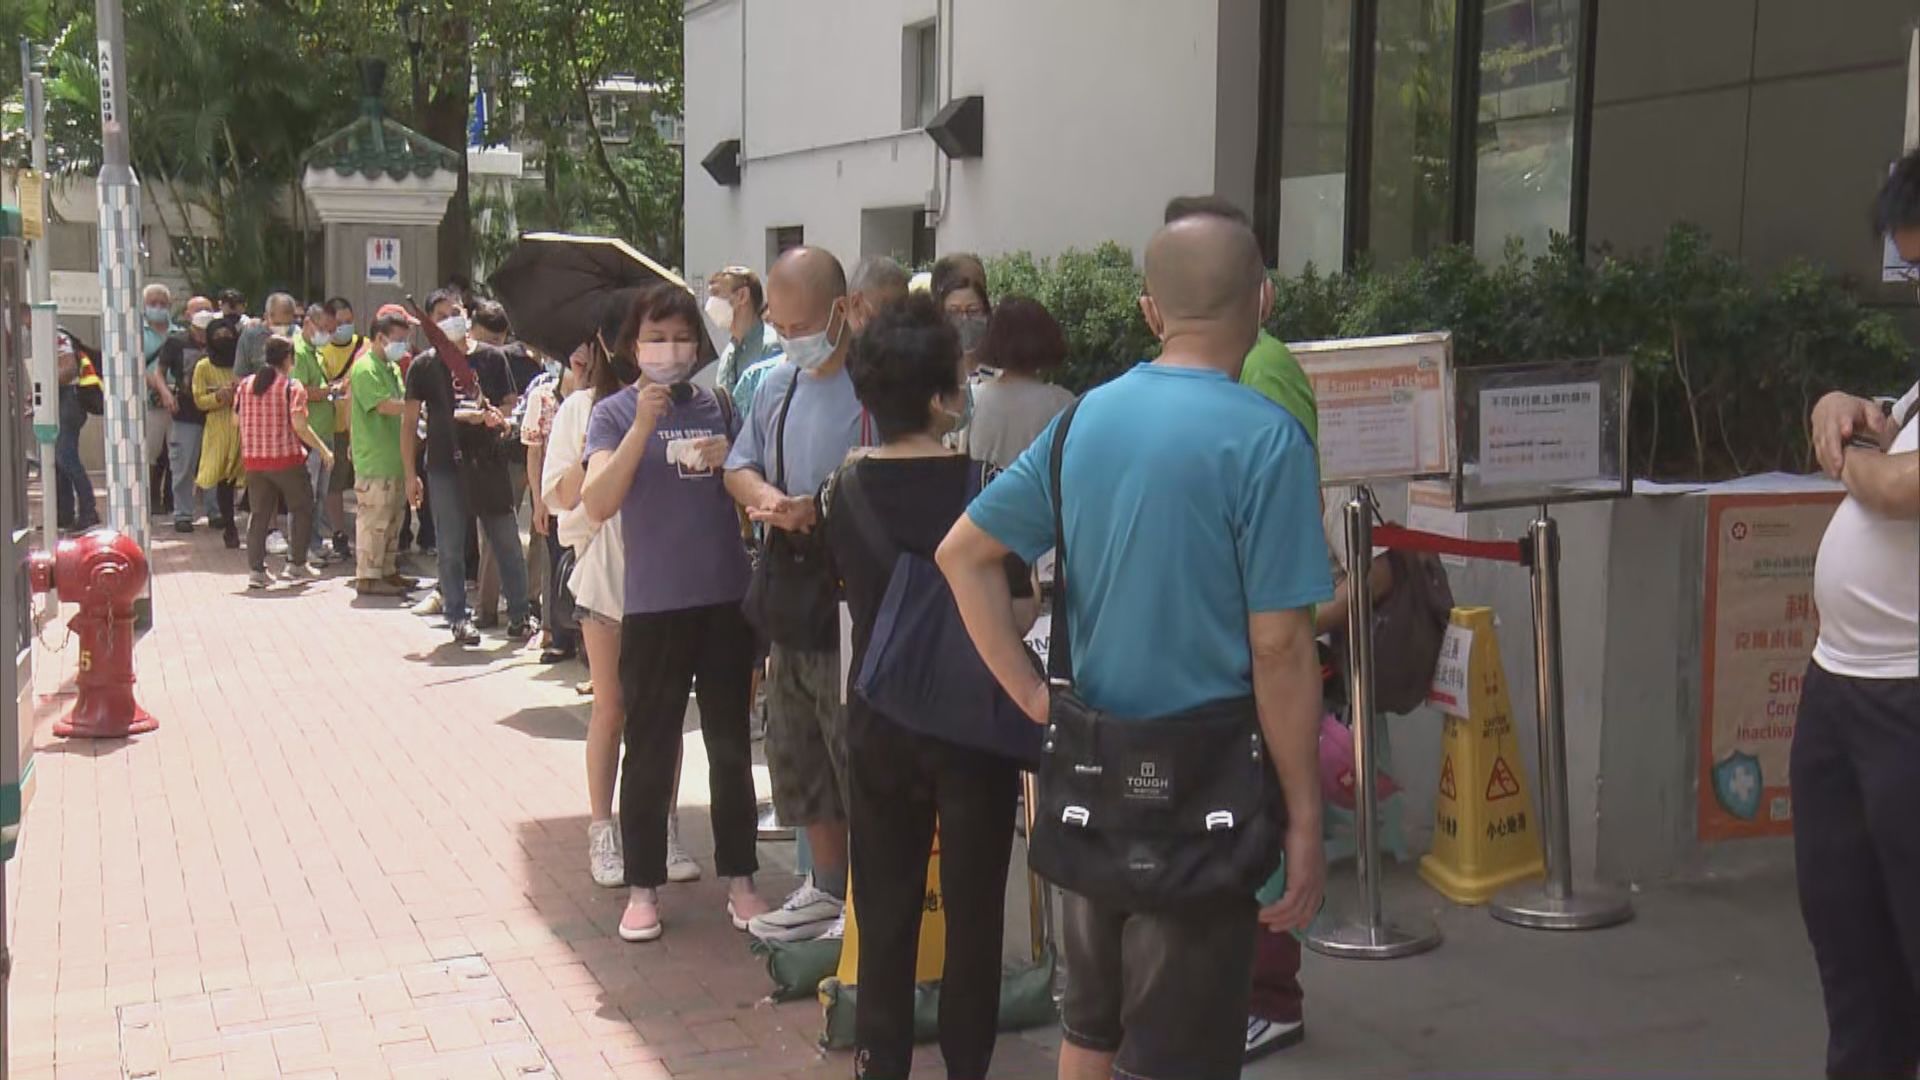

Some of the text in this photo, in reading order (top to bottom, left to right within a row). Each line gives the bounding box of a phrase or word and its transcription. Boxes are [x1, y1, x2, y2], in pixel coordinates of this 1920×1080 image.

[101, 51, 109, 71] AA
[657, 429, 683, 440] TEAM
[1768, 671, 1805, 694] Sin
[1737, 724, 1796, 740] Inactiva
[1127, 778, 1168, 788] TOUGH
